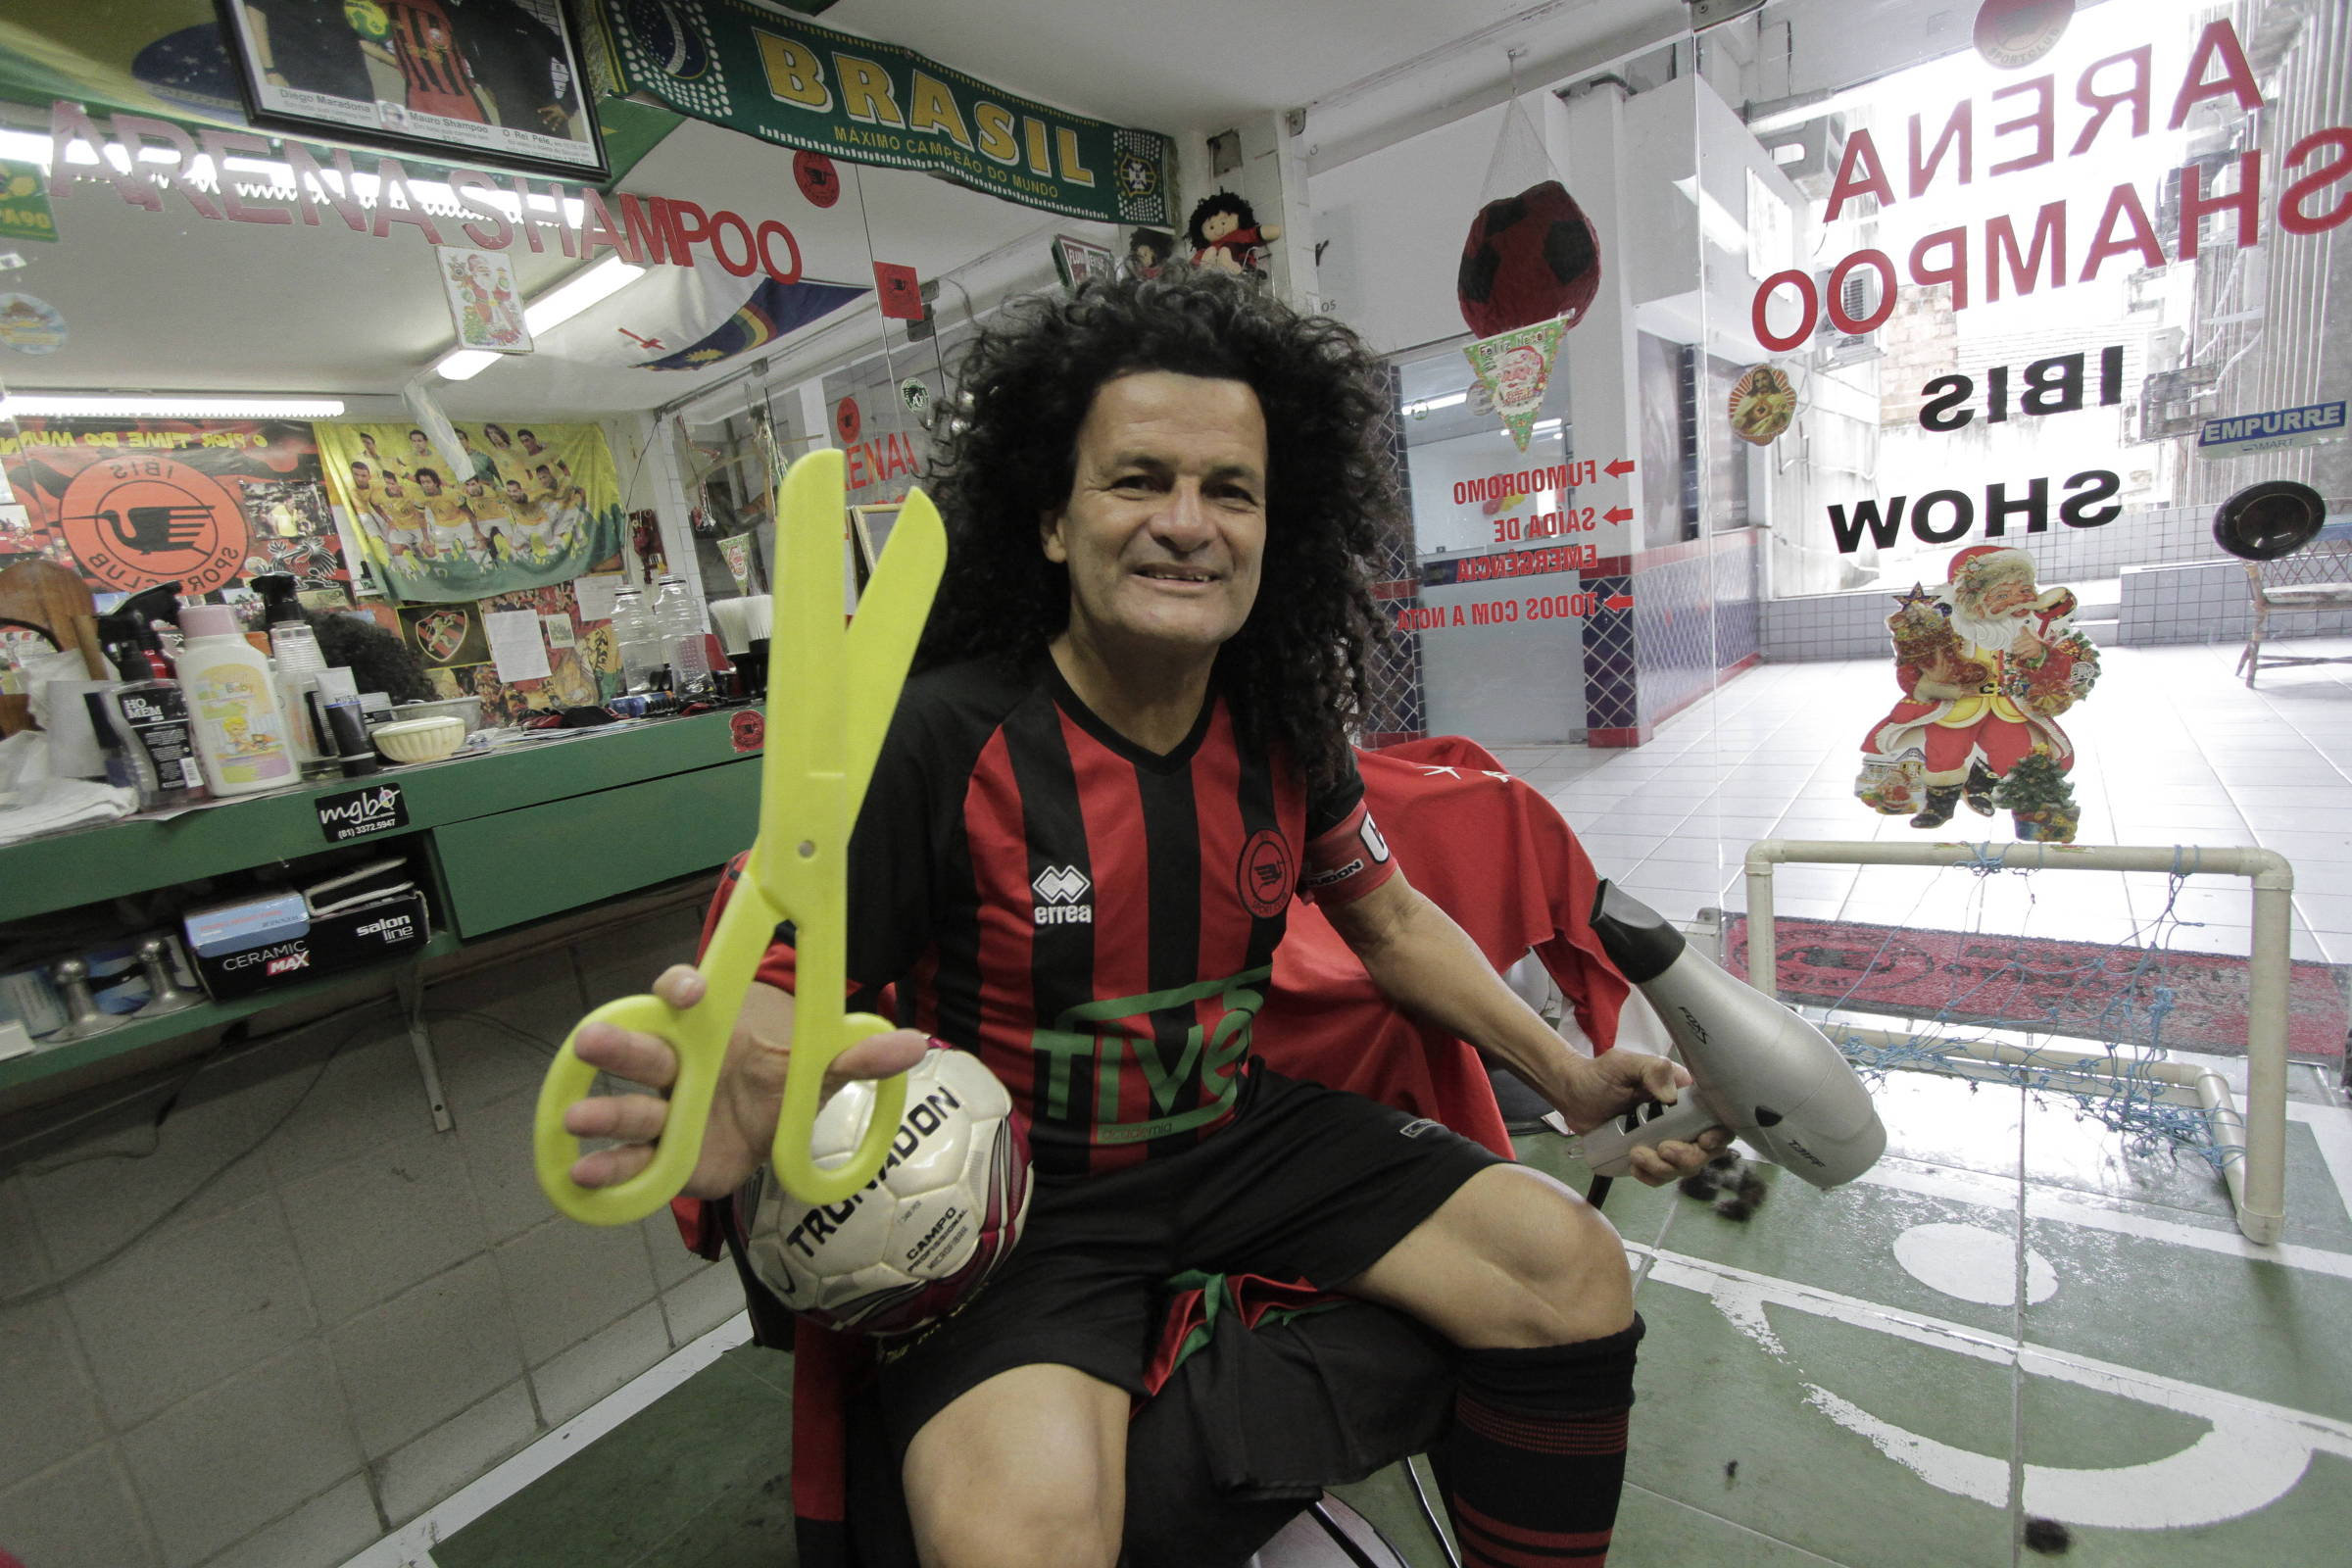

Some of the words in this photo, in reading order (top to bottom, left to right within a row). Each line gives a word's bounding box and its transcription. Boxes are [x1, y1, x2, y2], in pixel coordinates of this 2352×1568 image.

[280, 89, 314, 103] Diego
[317, 95, 370, 113] Maradona
[752, 26, 1095, 188] BRASIL
[410, 112, 440, 125] Mauro
[442, 118, 488, 134] Shampoo
[833, 125, 901, 150] MÁXIMO
[906, 138, 983, 173] CAMPEÃO
[988, 164, 1007, 183] DO
[1012, 173, 1058, 198] MUNDO
[50, 101, 443, 245] ARENA
[447, 169, 803, 285] SHAMPOO
[2205, 406, 2341, 442] EMPURRE
[123, 698, 146, 710] HO
[127, 706, 163, 719] MEM
[338, 829, 355, 839] (81)
[357, 818, 396, 834] 3372.5947
[356, 915, 411, 937] salon
[1034, 905, 1092, 924] errea
[383, 926, 414, 941] line
[222, 941, 307, 971] CERAMIC
[270, 951, 310, 974] MAX
[906, 1206, 957, 1260] CAMPO
